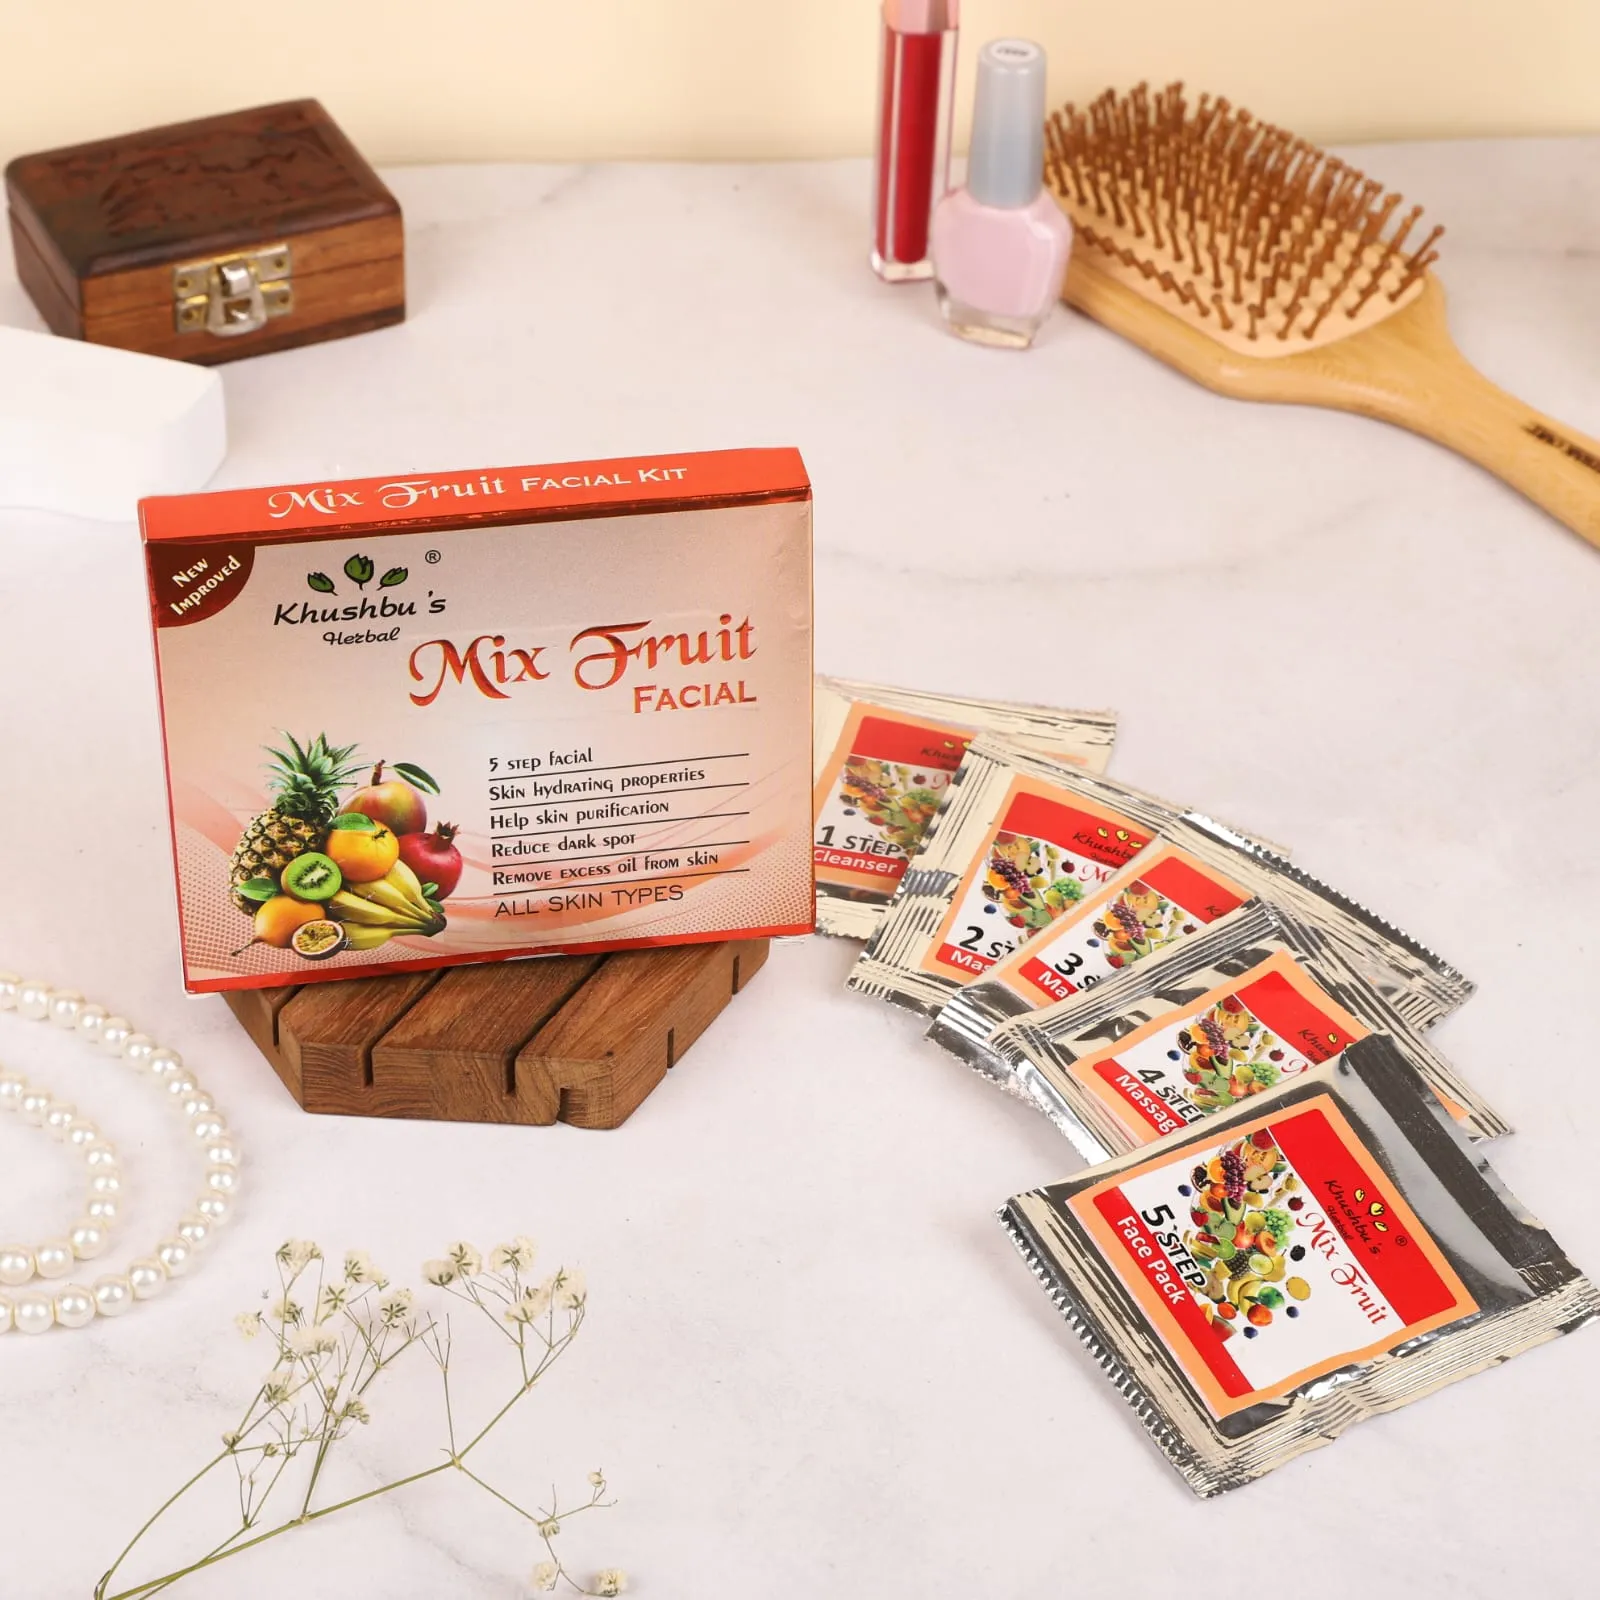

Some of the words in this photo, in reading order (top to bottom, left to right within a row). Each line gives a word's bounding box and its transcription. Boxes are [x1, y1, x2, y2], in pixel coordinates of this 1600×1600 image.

[267, 488, 365, 518] Mix
[377, 475, 506, 509] Fruit
[322, 627, 401, 646] Herbal
[408, 634, 551, 707] Mix
[569, 613, 758, 691] Fruit
[633, 680, 758, 714] FACIAL
[489, 757, 499, 772] 5
[816, 825, 836, 847] 1
[842, 835, 902, 856] STEP
[813, 849, 899, 873] Cleanser
[494, 900, 541, 918] ALL
[548, 891, 603, 912] SKIN
[611, 884, 684, 907] TYPES
[959, 925, 984, 952] 2
[1054, 952, 1084, 976] 3
[1137, 1069, 1166, 1084] 4
[1115, 1074, 1178, 1133] Massag
[1141, 1204, 1176, 1227] 5
[1117, 1215, 1153, 1258] Face
[1147, 1259, 1186, 1305] Pack
[1158, 1232, 1206, 1287] STEP
[1295, 1212, 1339, 1261] Mix
[1330, 1263, 1388, 1325] Fruit
